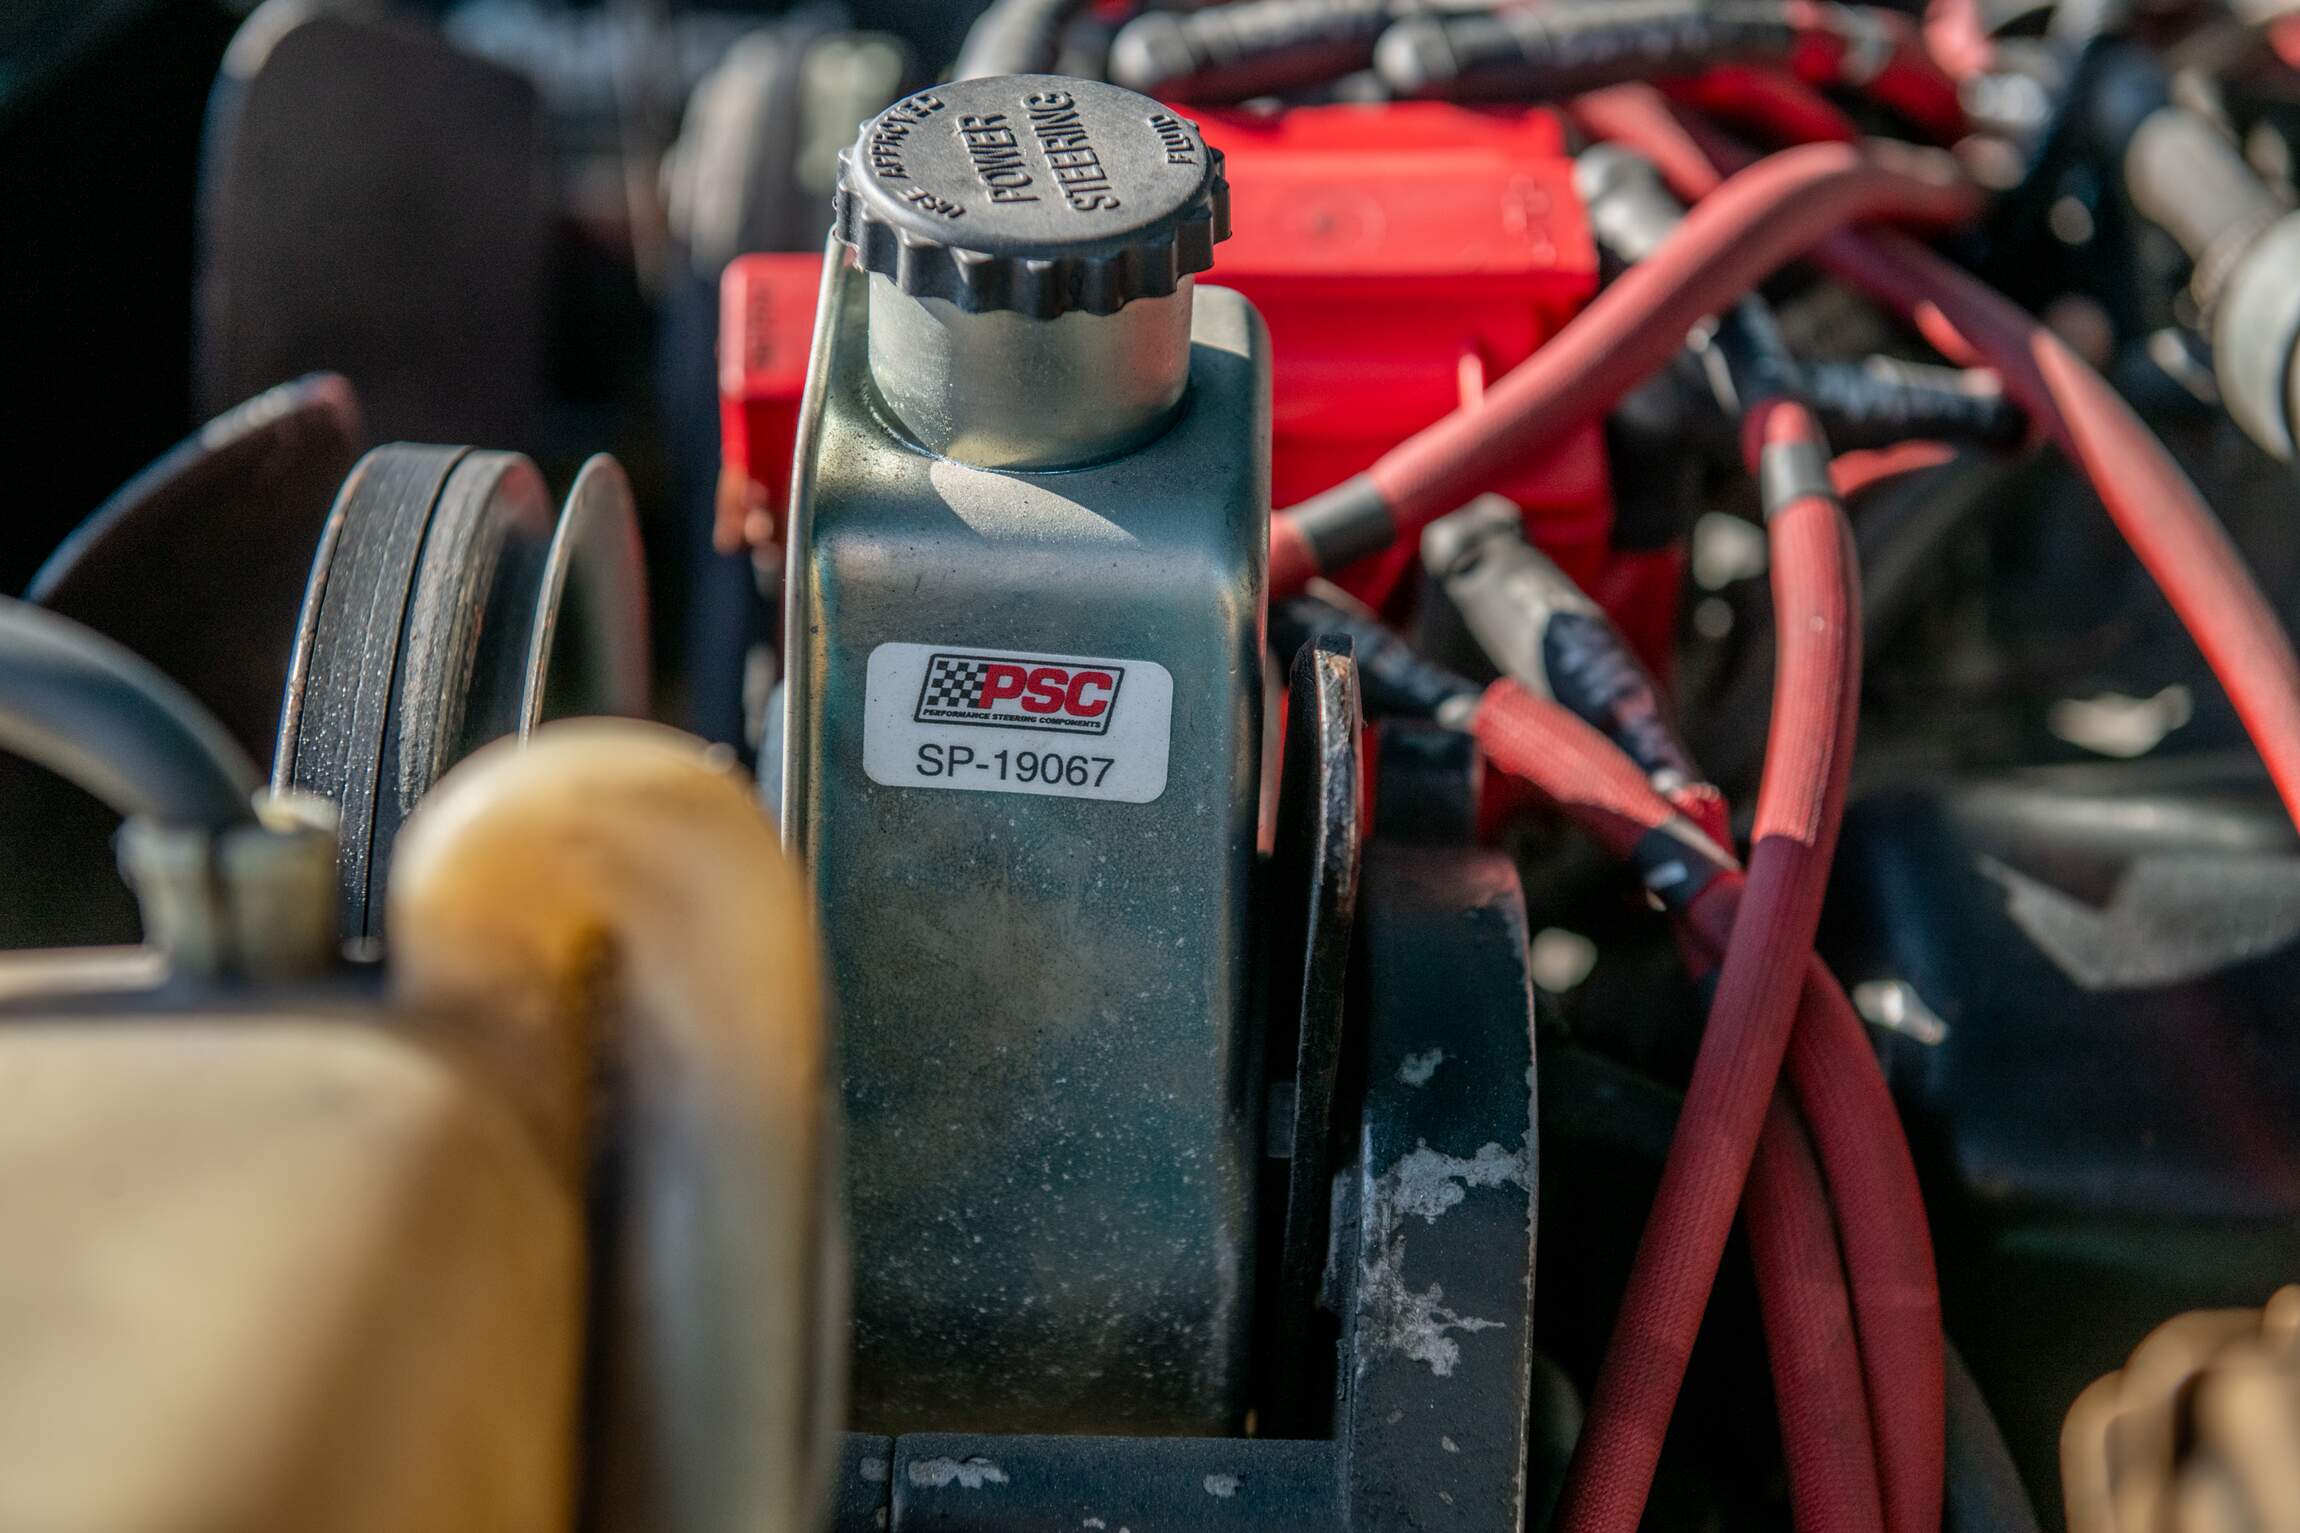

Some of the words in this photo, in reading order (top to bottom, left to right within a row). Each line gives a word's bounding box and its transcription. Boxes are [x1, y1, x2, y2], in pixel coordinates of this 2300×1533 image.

[870, 93, 945, 180] APPROVED
[956, 112, 1039, 203] POWER
[1021, 91, 1120, 211] STEERING
[1147, 114, 1197, 166] FLUID
[902, 186, 967, 218] USE
[978, 663, 1114, 718] PSC
[922, 708, 990, 721] PERFORMANCE
[992, 713, 1037, 723] STEERING
[1039, 716, 1101, 728] COMPONENTS
[915, 743, 1115, 788] SP-19067
